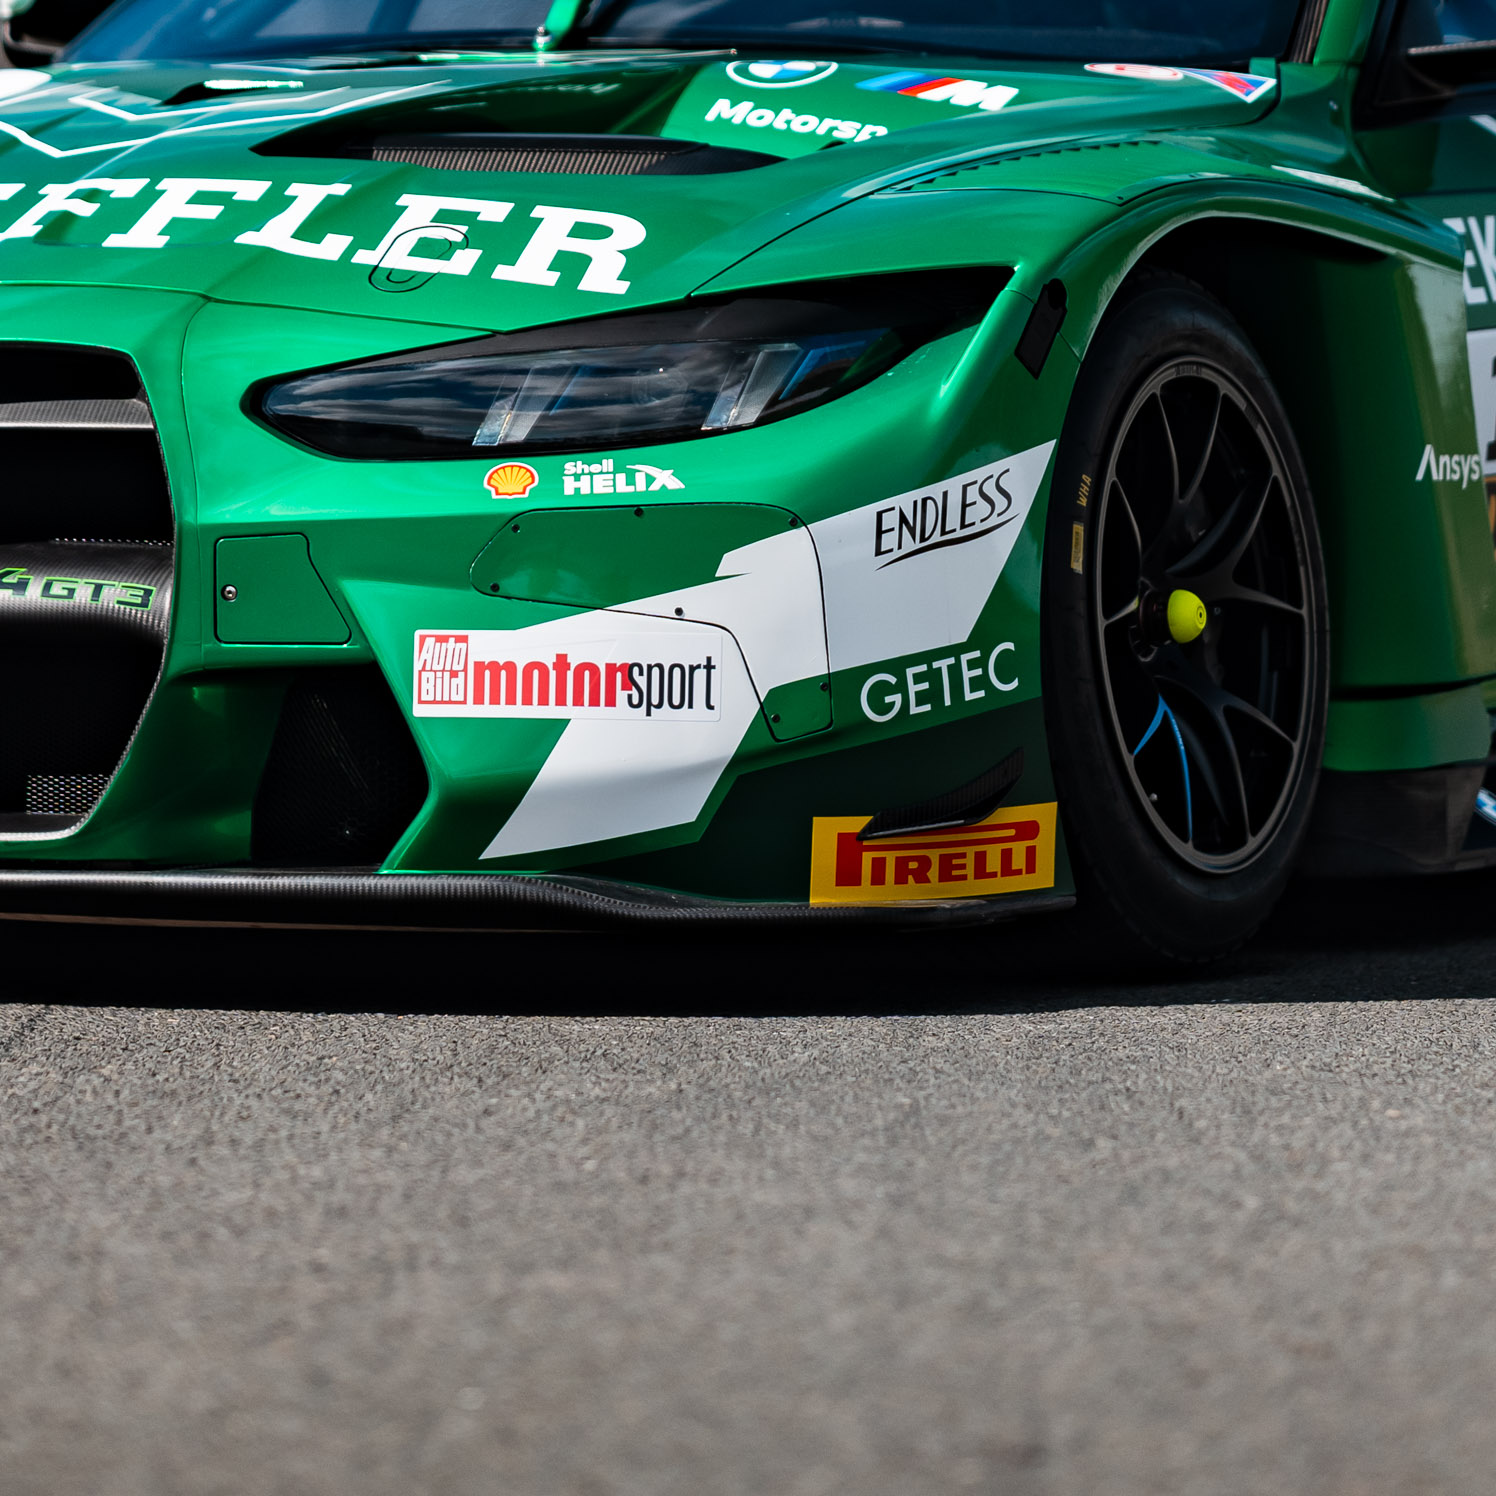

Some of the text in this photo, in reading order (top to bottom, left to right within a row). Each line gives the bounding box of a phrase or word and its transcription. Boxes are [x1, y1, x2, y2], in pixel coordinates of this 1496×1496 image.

[563, 459, 614, 475] Shell
[563, 464, 685, 495] HELIX
[1415, 444, 1481, 489] Ansys
[874, 468, 1013, 558] ENDLESS
[40, 578, 156, 610] GT3
[418, 636, 468, 671] Auto
[421, 671, 464, 702] Bild
[473, 653, 716, 717] motorsport
[861, 642, 1019, 722] GETEC
[835, 820, 1040, 887] PIRELLI
